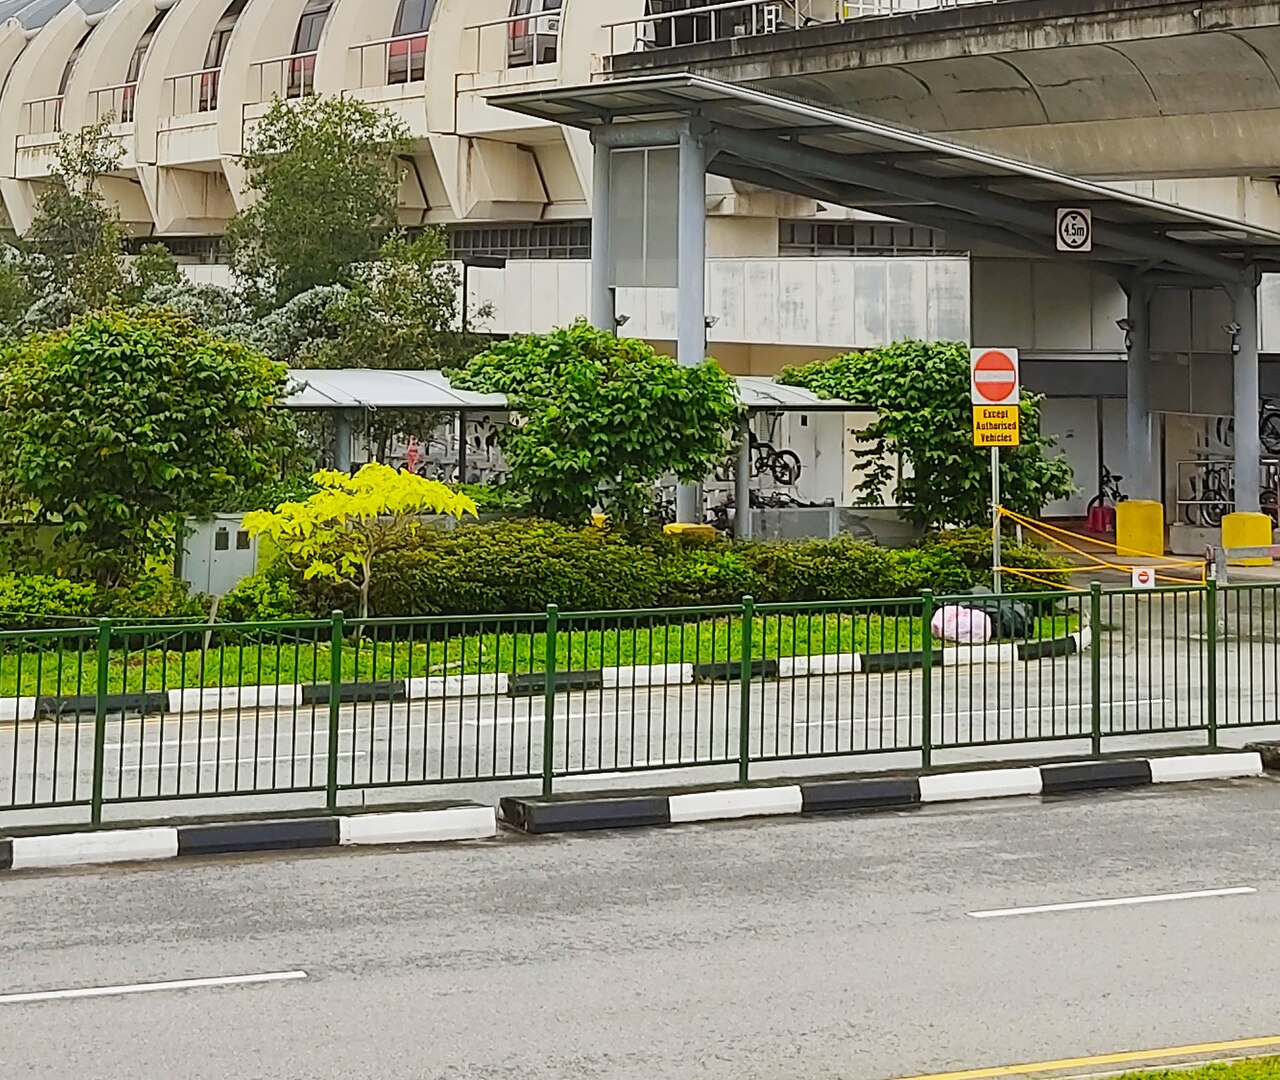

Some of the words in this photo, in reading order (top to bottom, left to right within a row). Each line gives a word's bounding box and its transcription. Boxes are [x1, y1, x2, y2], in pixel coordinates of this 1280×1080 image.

[1064, 222, 1085, 237] 4.5m
[983, 409, 1009, 419] Except
[976, 421, 1017, 431] Authorised
[980, 432, 1013, 443] Vehicles
